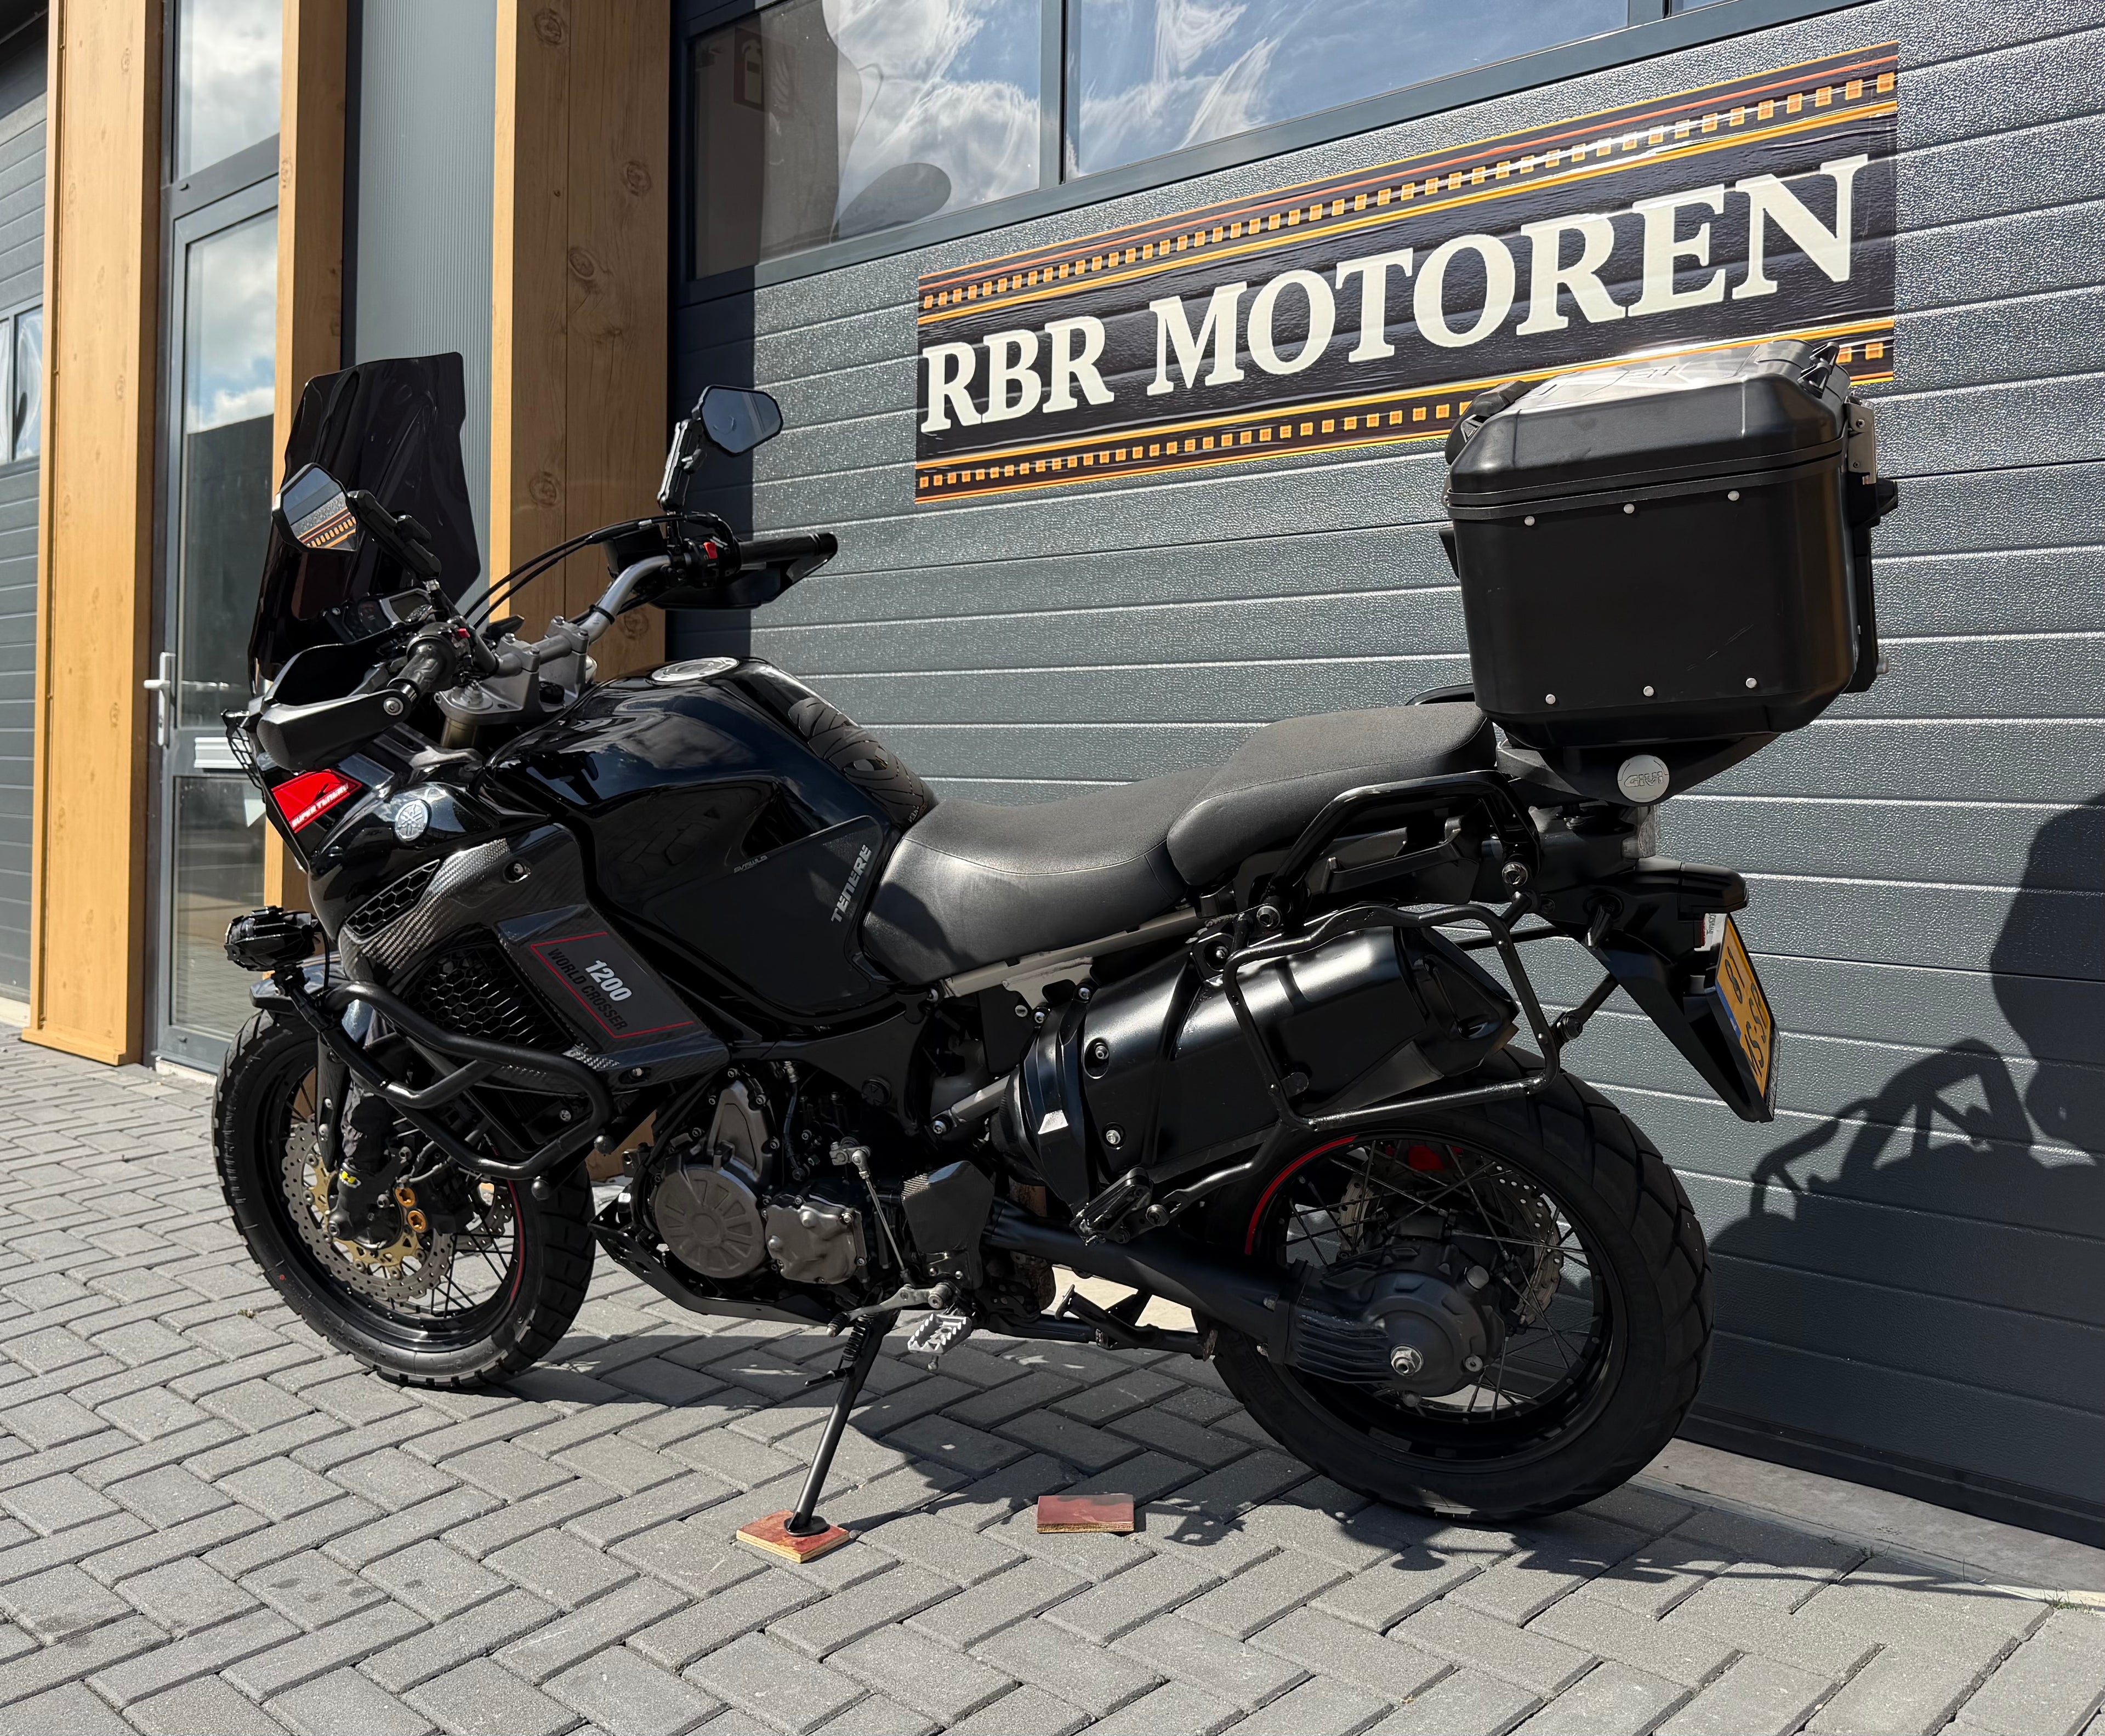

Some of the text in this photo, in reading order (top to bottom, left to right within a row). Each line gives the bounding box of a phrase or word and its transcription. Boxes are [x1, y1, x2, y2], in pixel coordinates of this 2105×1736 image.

[920, 153, 1868, 433] RBR MOTOREN
[1624, 771, 1664, 788] GIVI
[548, 948, 628, 1031] WORLD CROSSER
[585, 960, 632, 1001] 1200
